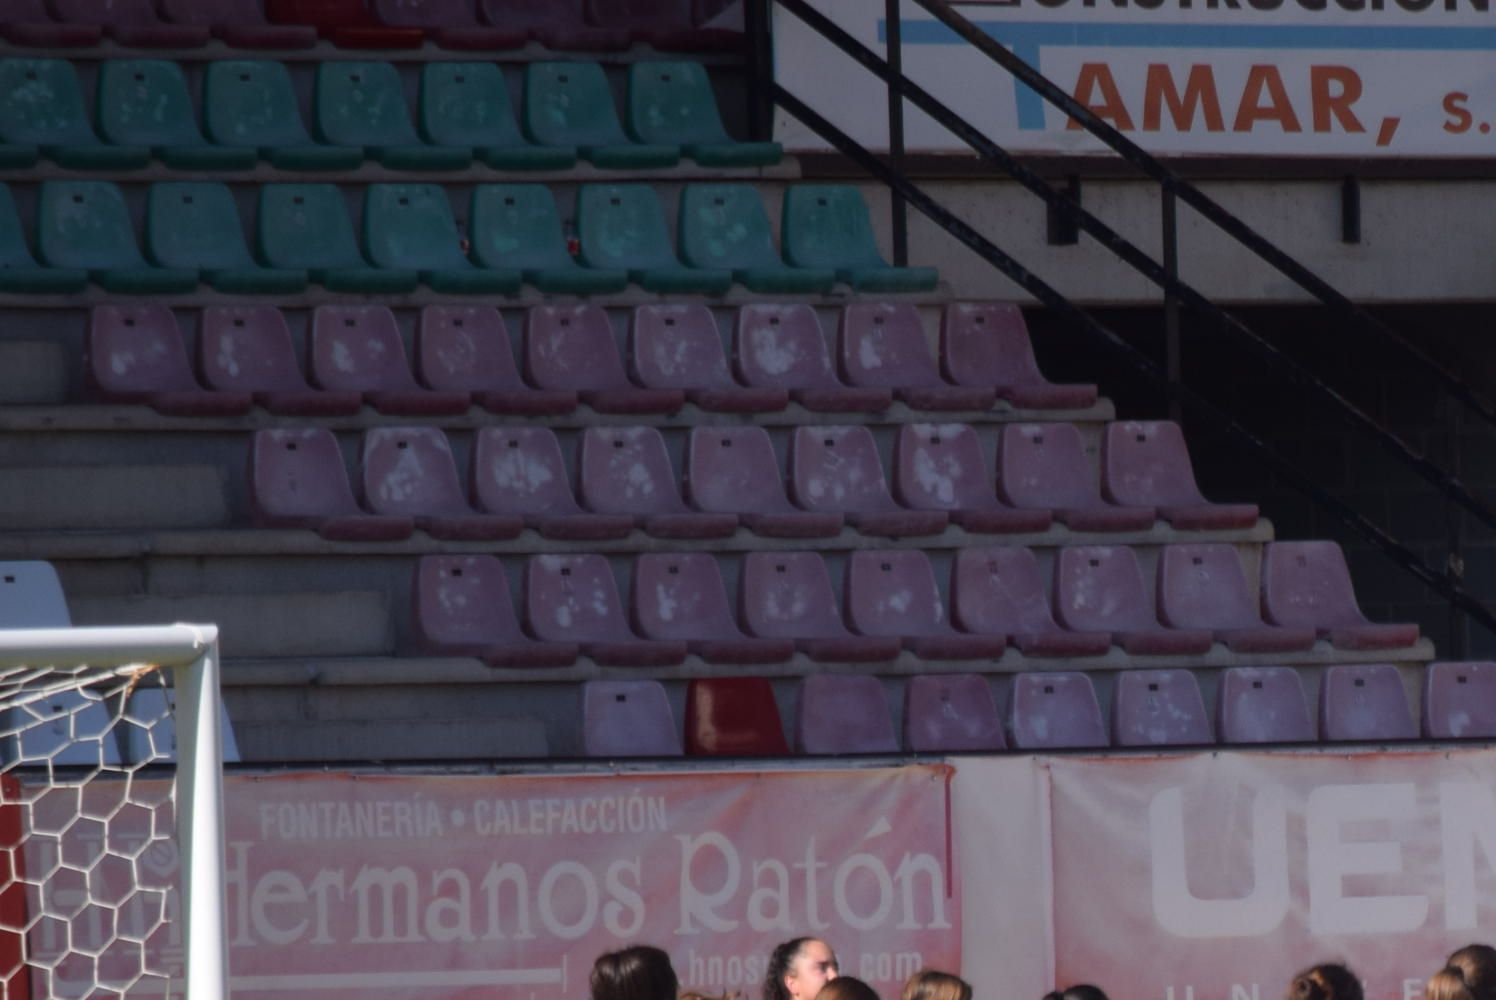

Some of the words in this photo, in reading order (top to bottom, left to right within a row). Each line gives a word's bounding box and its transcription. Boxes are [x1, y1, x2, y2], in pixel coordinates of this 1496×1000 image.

[259, 794, 444, 839] FONTANERÍA
[474, 789, 668, 835] CALEFACCIÓN
[672, 816, 953, 936] Ratón
